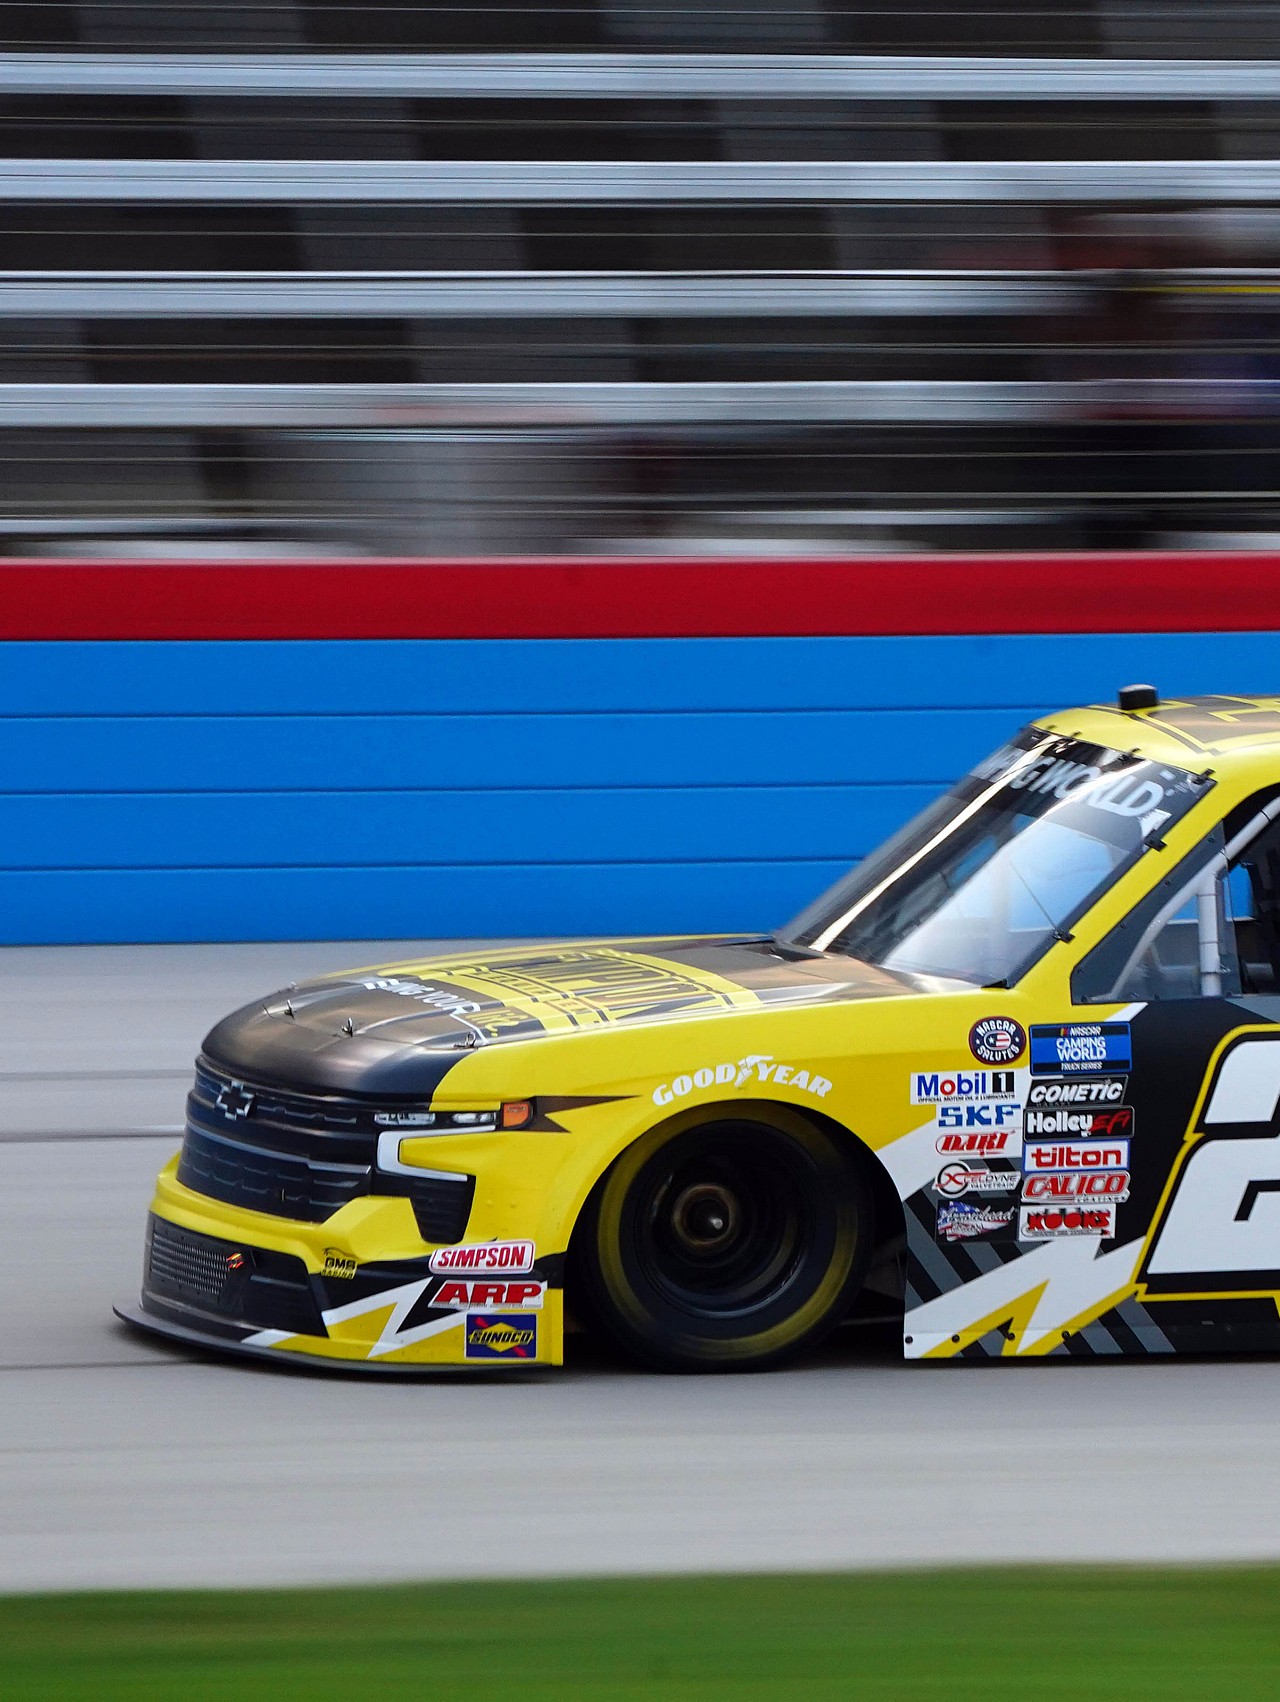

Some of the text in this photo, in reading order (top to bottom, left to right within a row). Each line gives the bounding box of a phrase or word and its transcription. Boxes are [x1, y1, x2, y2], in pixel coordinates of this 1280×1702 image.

[975, 1019, 1018, 1037] NASCAR
[1069, 1026, 1102, 1036] NASCAR
[976, 1043, 1020, 1062] SALUTES
[1056, 1036, 1106, 1050] CAMPING
[1056, 1048, 1107, 1061] WORLD
[917, 1072, 986, 1096] Mobil
[1030, 1081, 1123, 1103] COMETIC
[939, 1104, 1021, 1127] SKF
[1027, 1110, 1093, 1137] Holley
[1031, 1146, 1122, 1167] tilton
[1024, 1173, 1128, 1198] CALICO
[1027, 1209, 1111, 1231] KOOKS
[324, 1257, 357, 1270] GMS
[437, 1244, 527, 1268] SIMPSON
[430, 1282, 543, 1304] ARP
[468, 1329, 534, 1345] SUNOCO
